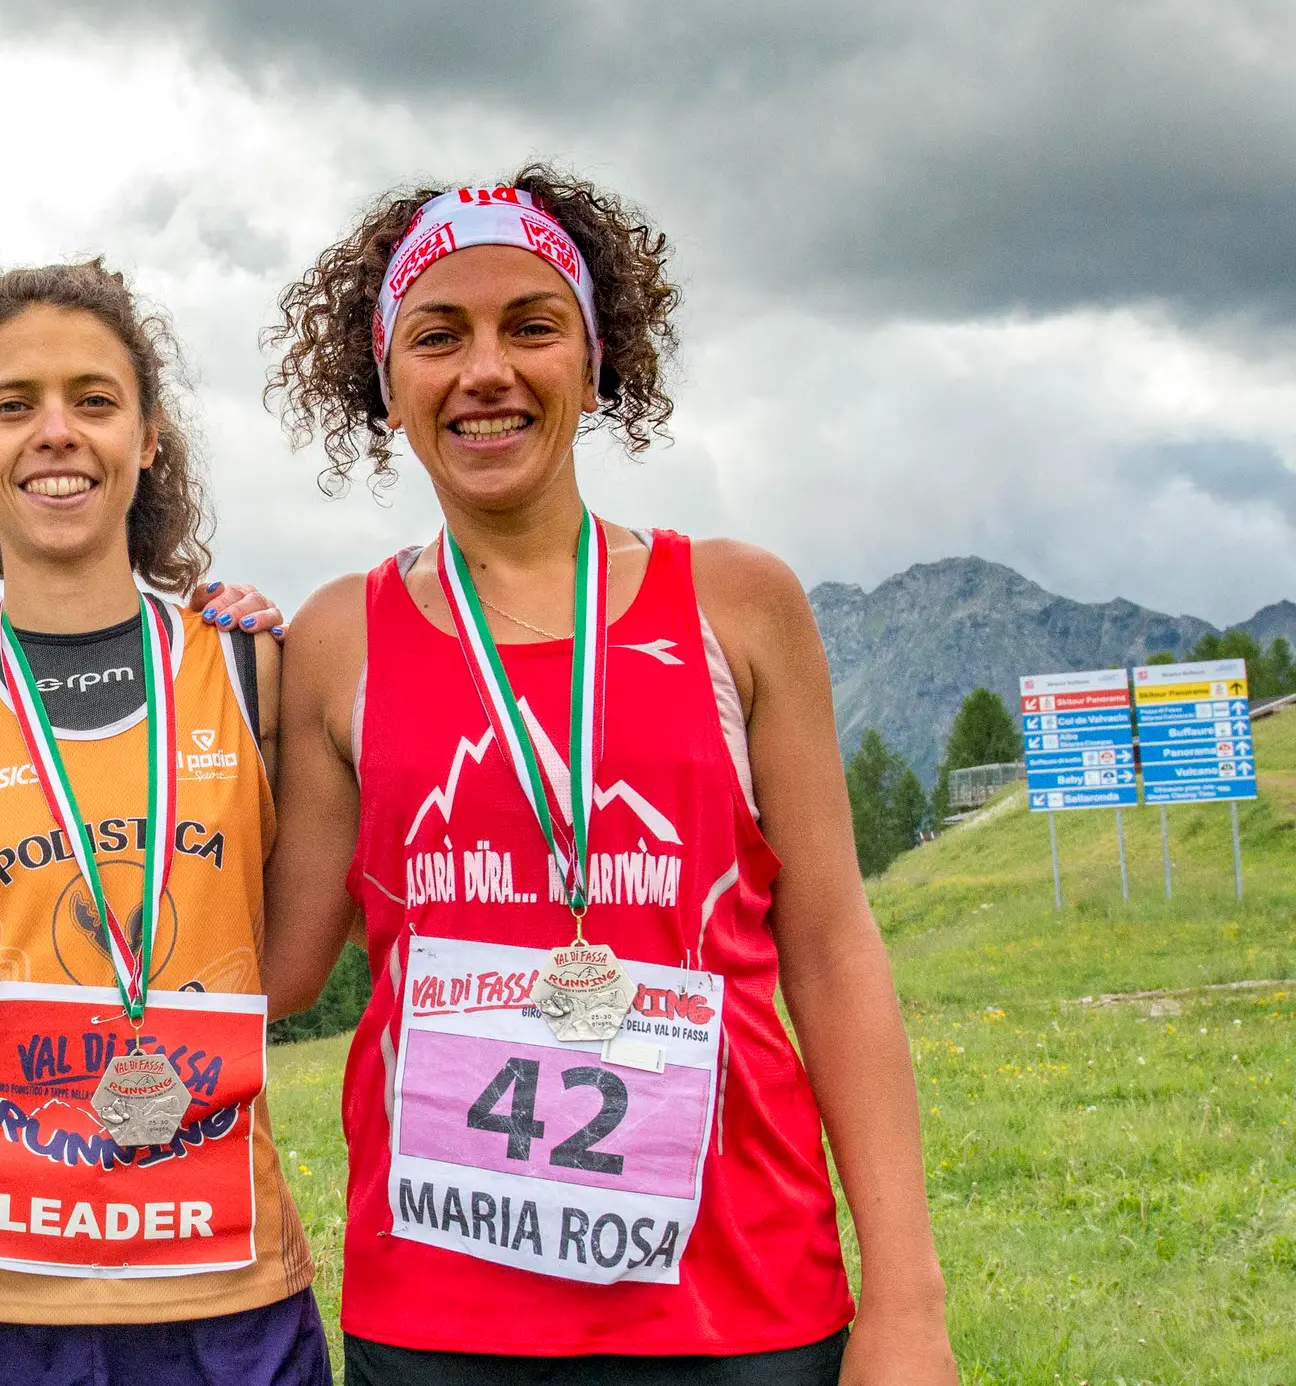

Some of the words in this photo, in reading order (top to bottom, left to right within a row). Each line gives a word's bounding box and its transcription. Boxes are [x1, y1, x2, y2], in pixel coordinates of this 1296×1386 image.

[187, 748, 238, 773] podio
[1162, 747, 1217, 758] Panorama
[1057, 775, 1084, 786] Baby
[1174, 766, 1218, 777] Vulcano
[553, 953, 569, 966] VAL
[579, 950, 608, 965] FASSA
[548, 969, 616, 988] RUNNING
[411, 975, 446, 1009] VAL
[626, 1019, 652, 1034] DELLA
[654, 1023, 670, 1037] VAL
[672, 1026, 680, 1038] DI
[682, 1027, 709, 1043] FASSA
[17, 1034, 72, 1082] VAL
[114, 1061, 128, 1074] VAL
[139, 1059, 165, 1072] FASSA
[109, 1077, 172, 1095] RUNNING
[466, 1056, 629, 1177] 42
[399, 1177, 543, 1257] MARIA
[558, 1206, 680, 1270] ROSA
